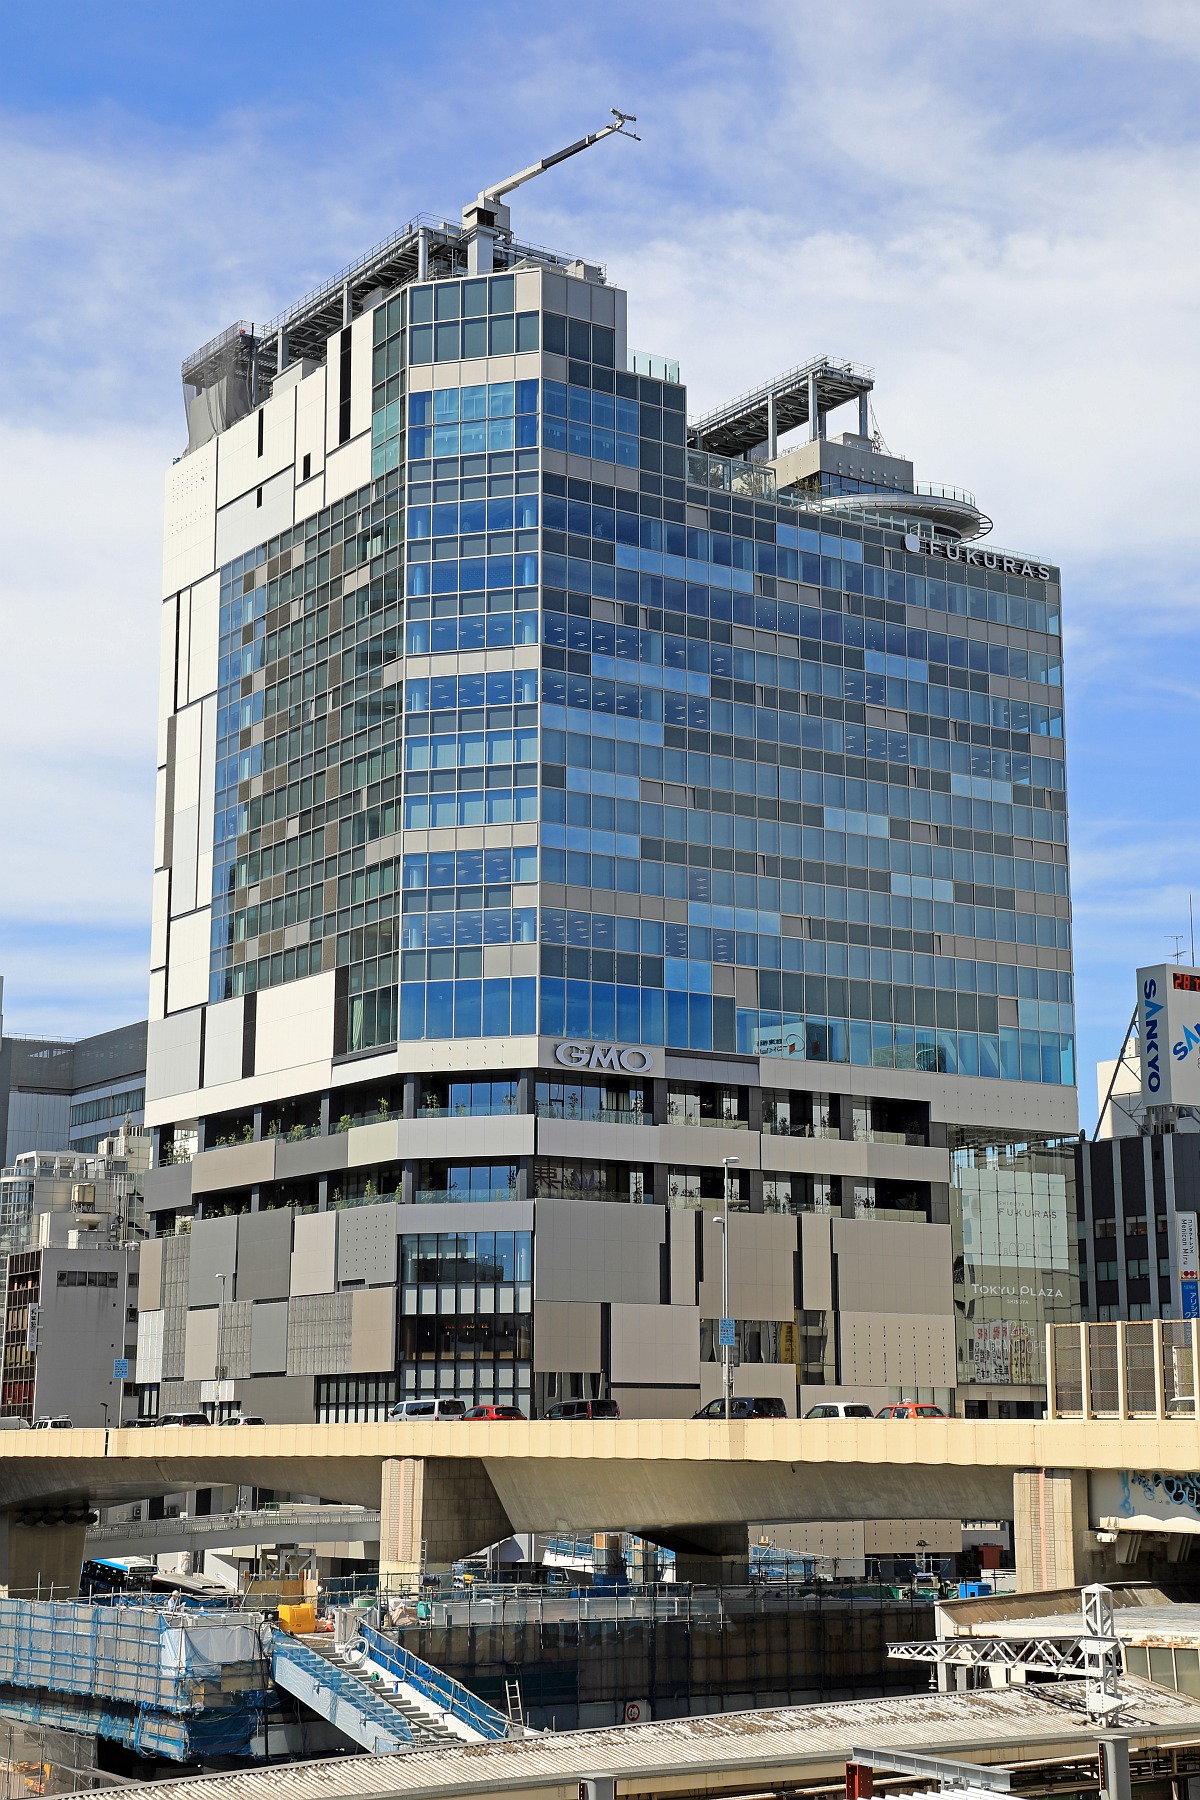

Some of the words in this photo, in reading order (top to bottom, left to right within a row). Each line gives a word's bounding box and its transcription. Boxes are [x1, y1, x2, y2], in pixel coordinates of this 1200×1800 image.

[930, 540, 1050, 581] FUKURAS
[1144, 979, 1165, 1093] SANKYO
[555, 1041, 654, 1073] GMO
[998, 1207, 1057, 1219] FUKURAS
[971, 1283, 1015, 1295] TOKYU
[1020, 1285, 1064, 1298] PLAZA
[1026, 1340, 1046, 1354] OPE
